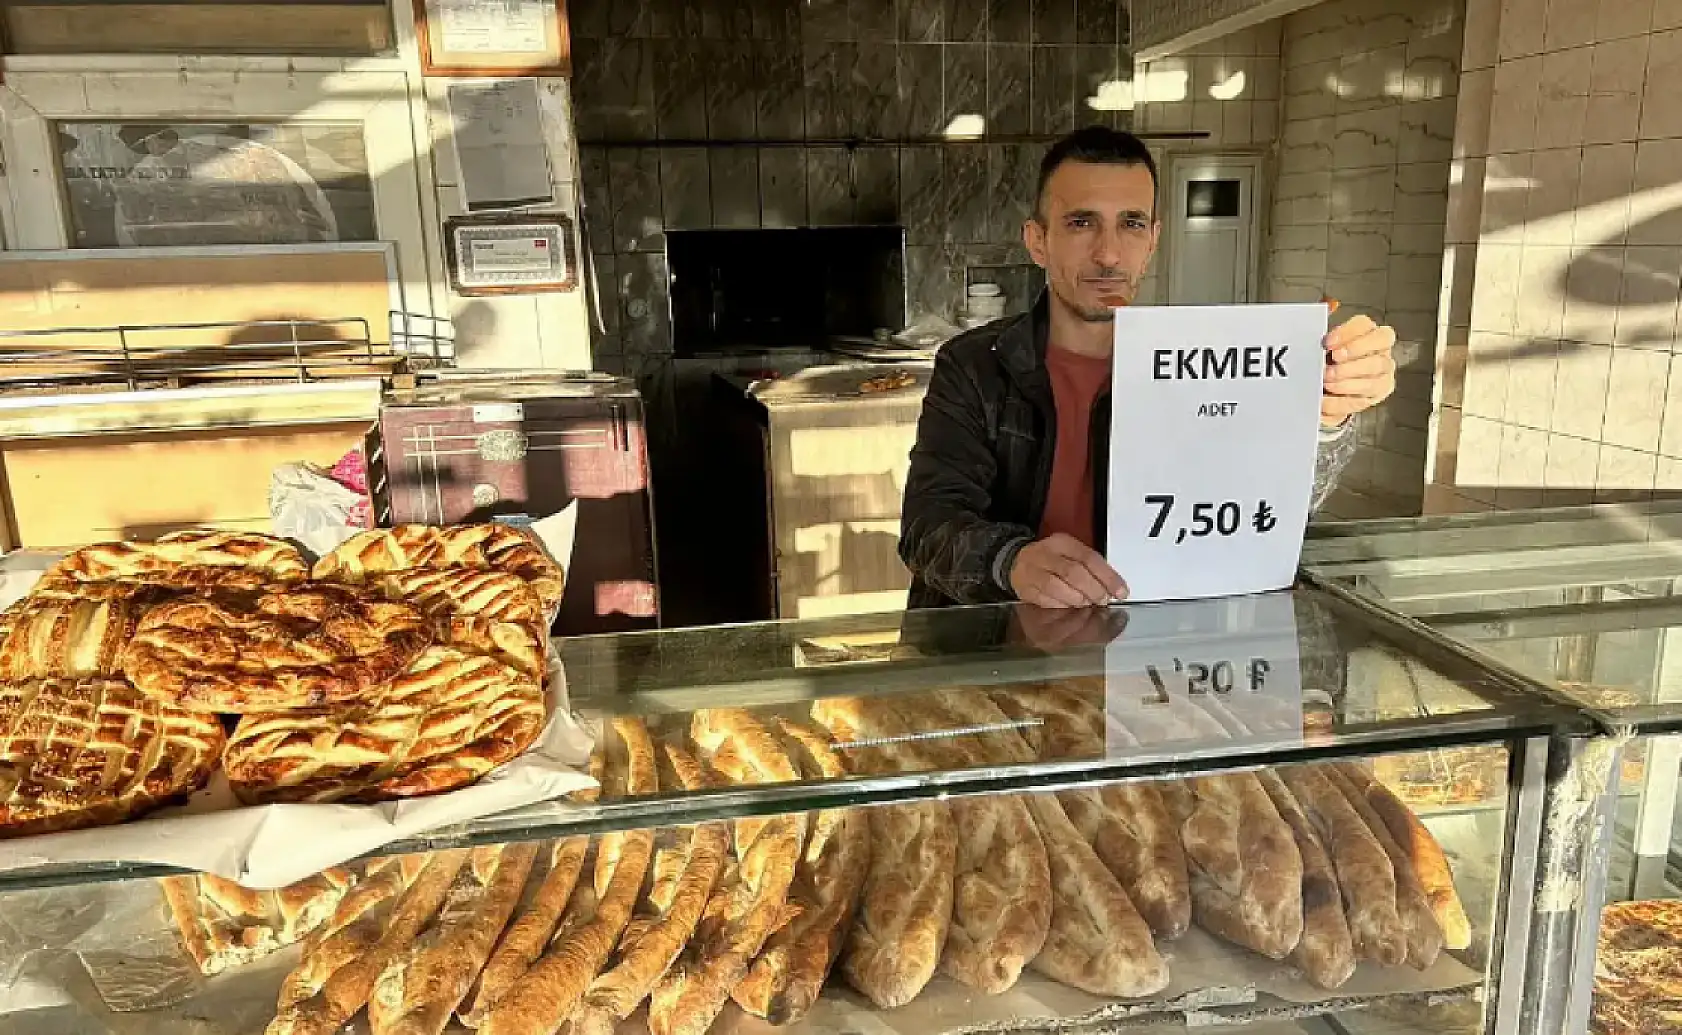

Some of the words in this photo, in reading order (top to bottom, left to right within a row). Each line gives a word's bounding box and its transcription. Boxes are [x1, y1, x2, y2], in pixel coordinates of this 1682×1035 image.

[1153, 346, 1288, 380] EKMEK
[1197, 402, 1238, 417] ADET
[1144, 495, 1241, 544] 7,50
[1252, 501, 1277, 533] ₺
